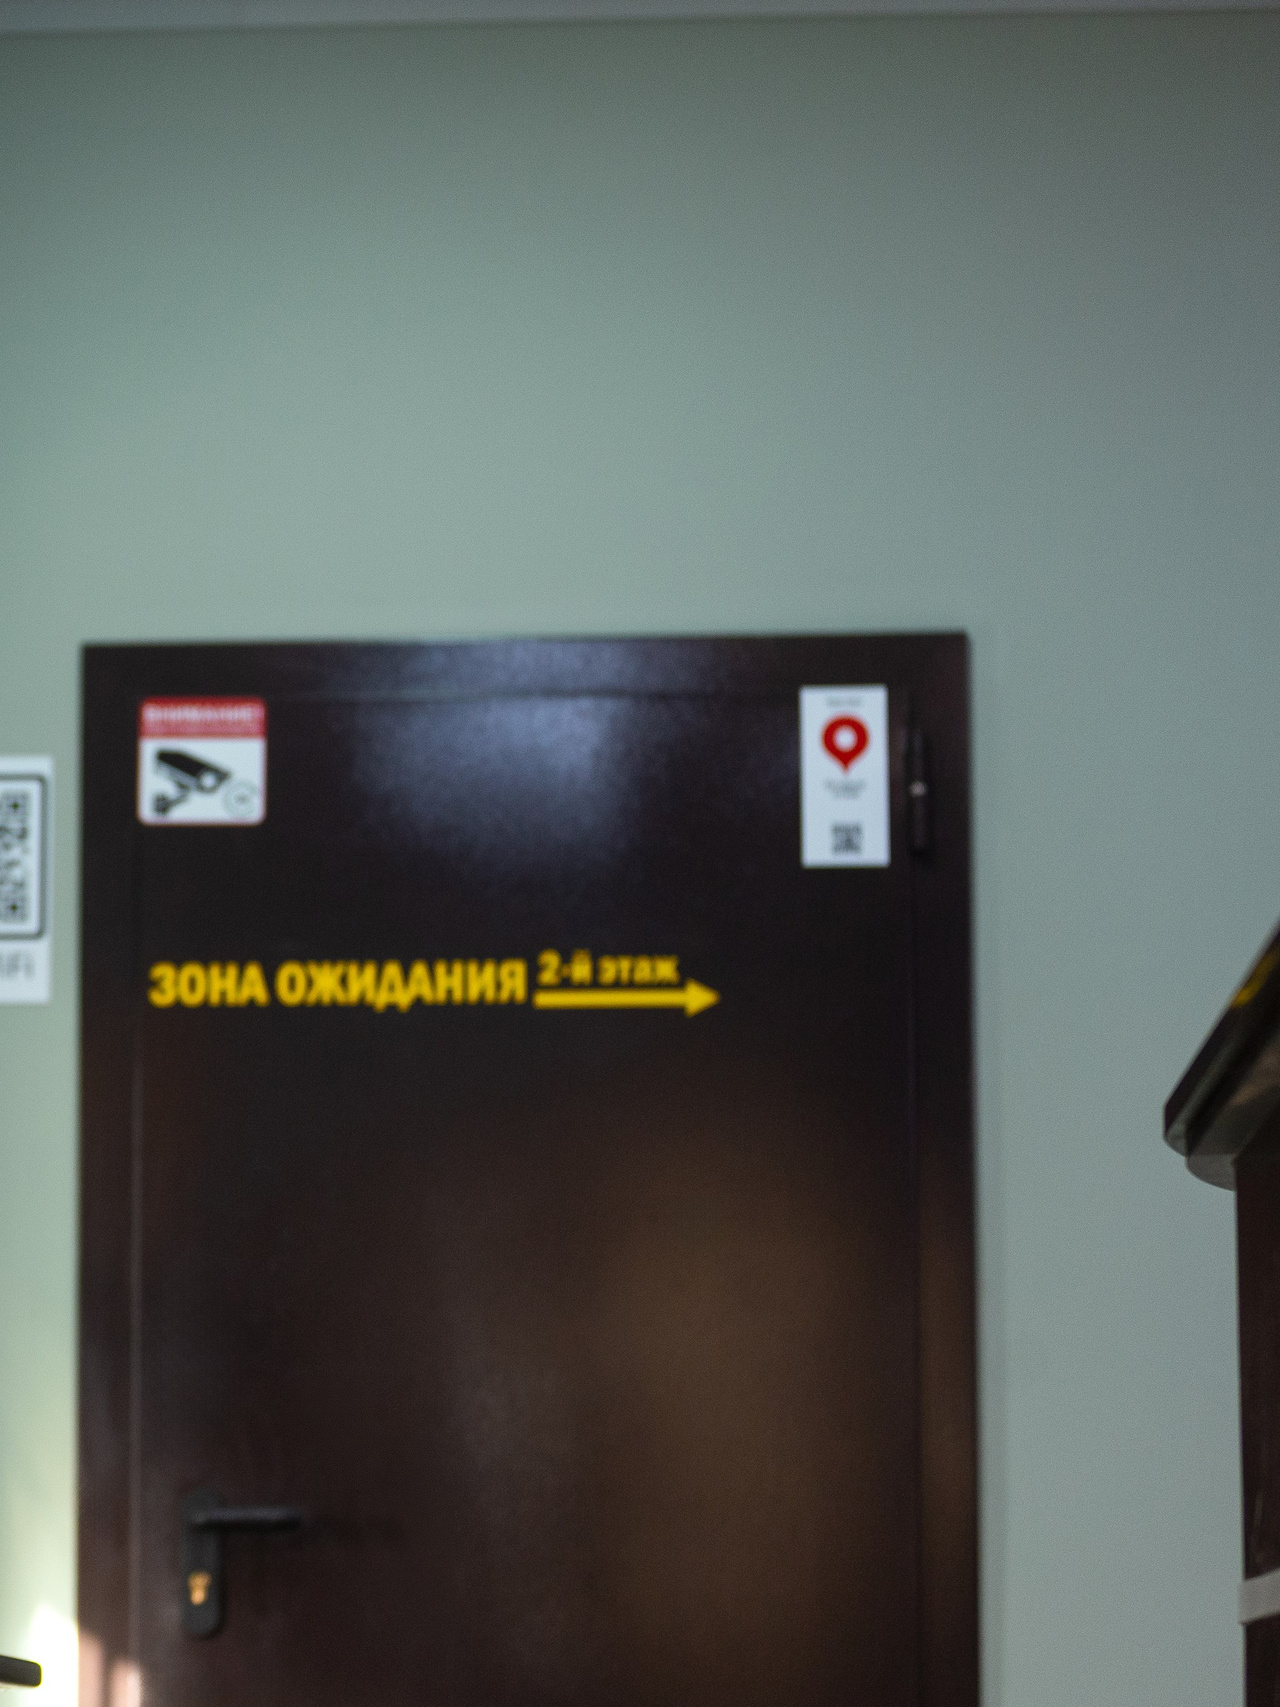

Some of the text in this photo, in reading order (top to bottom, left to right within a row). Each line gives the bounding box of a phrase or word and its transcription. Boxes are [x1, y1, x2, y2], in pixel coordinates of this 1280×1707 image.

[148, 950, 679, 1013] ЗОНА ОЖИДАНИЯ 2-й этаж
